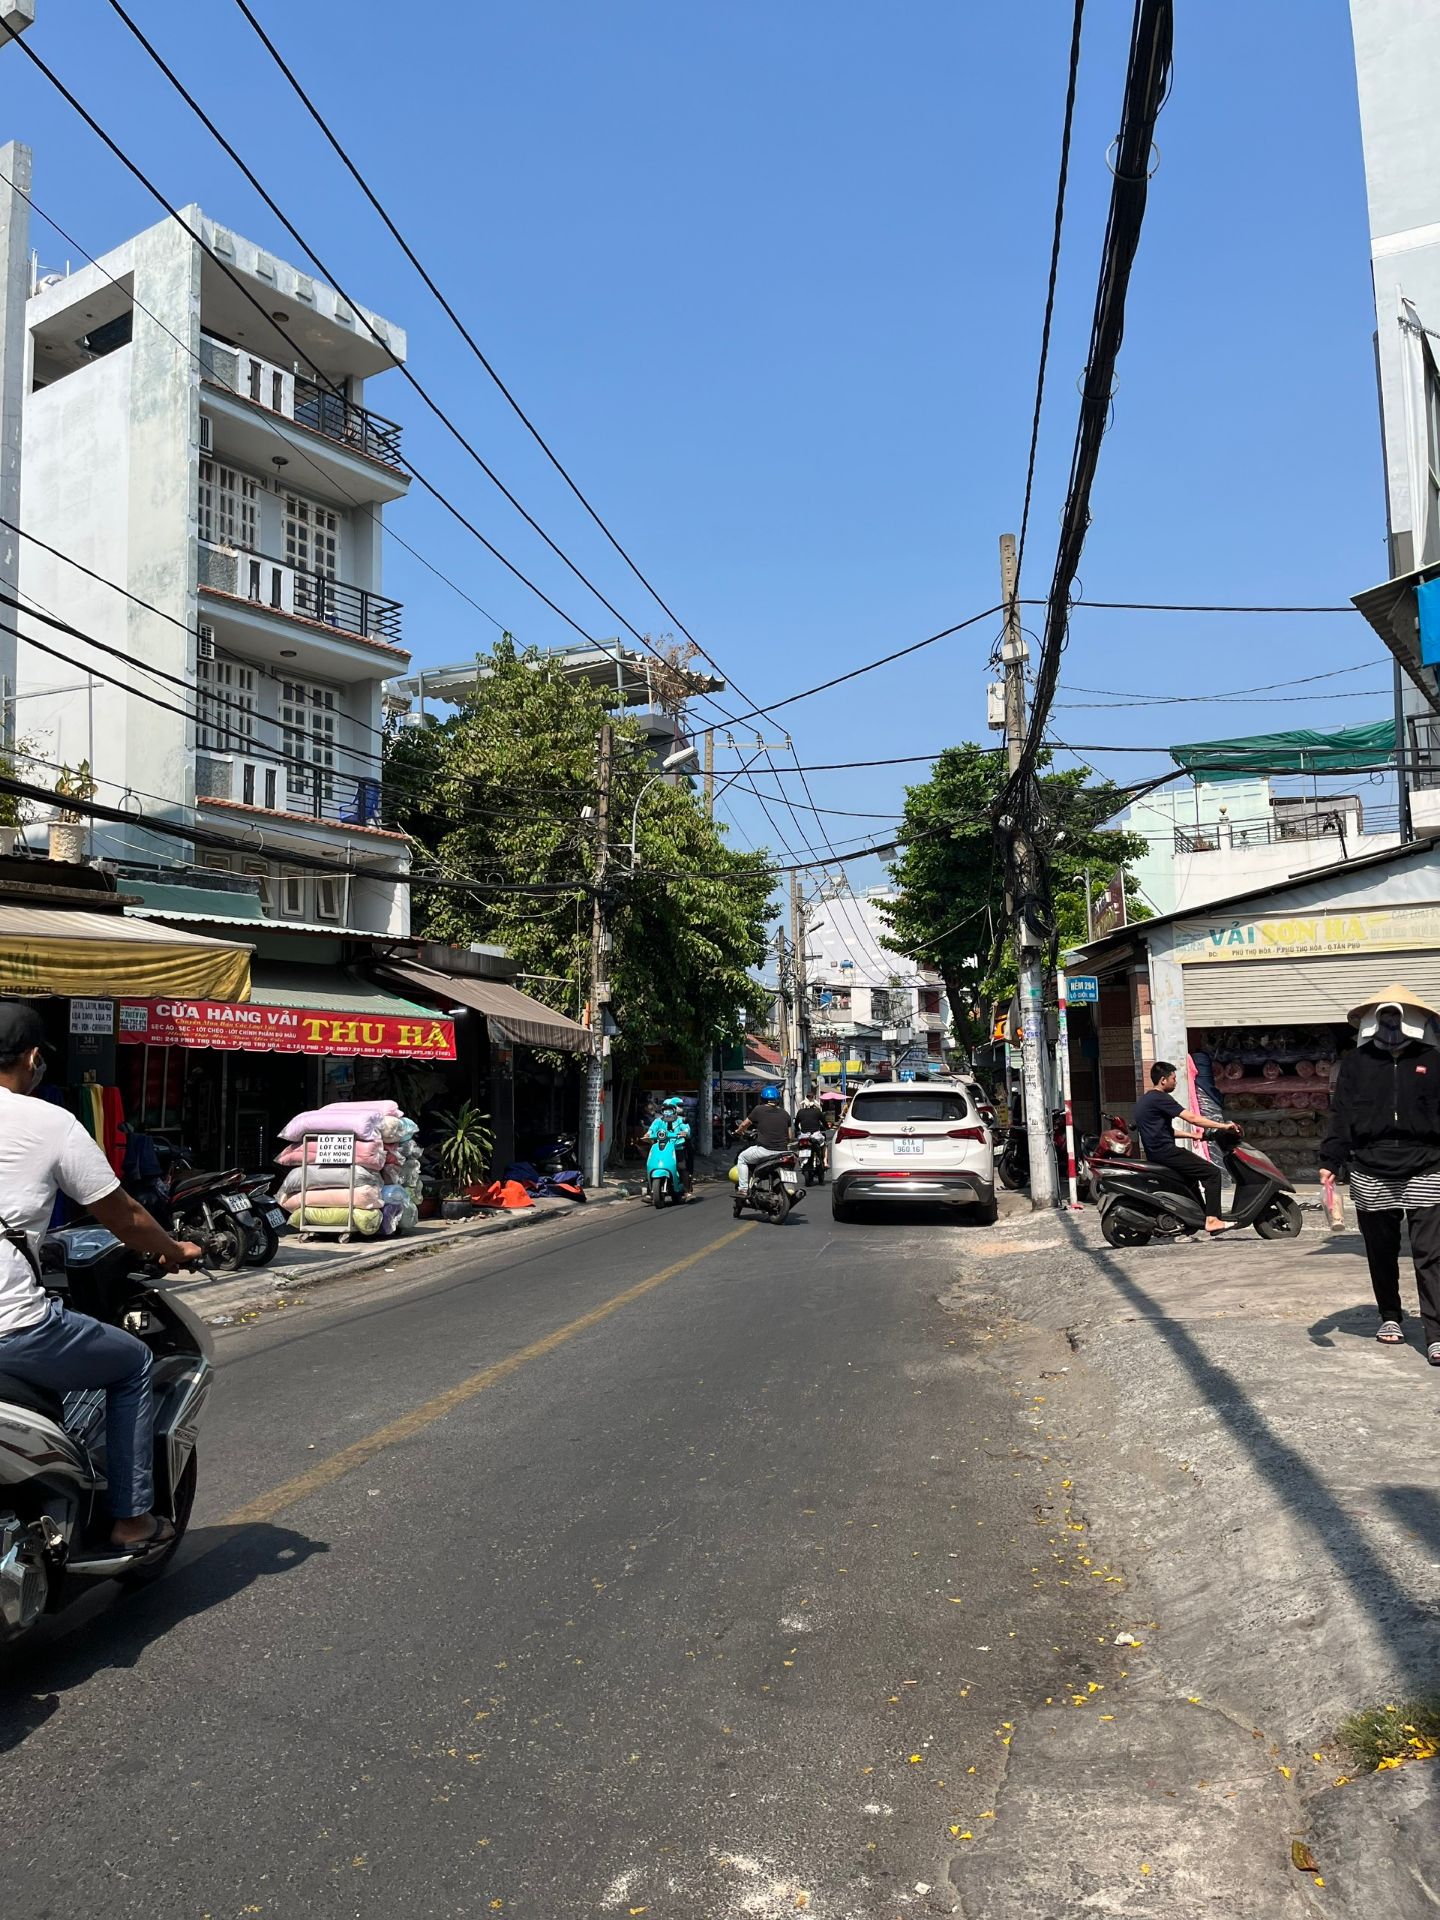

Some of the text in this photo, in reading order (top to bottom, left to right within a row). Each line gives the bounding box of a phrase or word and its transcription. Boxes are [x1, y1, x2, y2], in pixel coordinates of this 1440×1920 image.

[1208, 920, 1256, 946] VẢI
[155, 1001, 298, 1026] CỬA HÀNG VẢI
[302, 1018, 450, 1048] THU HÀ
[319, 1135, 335, 1143] LÓT
[902, 1138, 915, 1146] 61A
